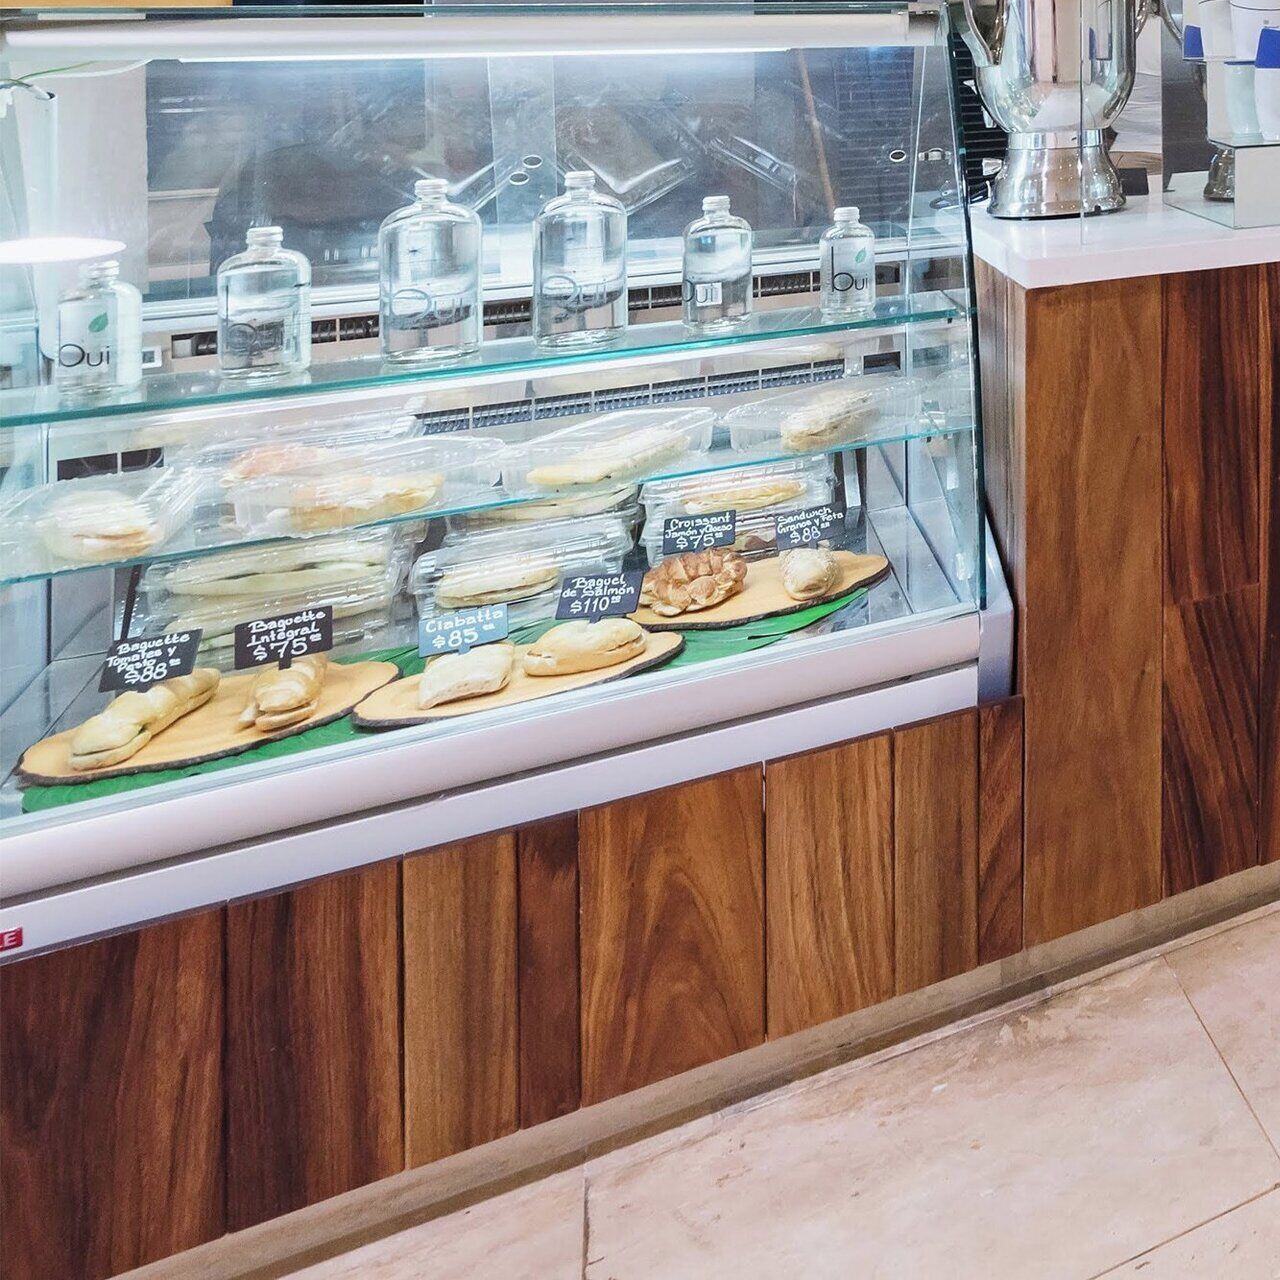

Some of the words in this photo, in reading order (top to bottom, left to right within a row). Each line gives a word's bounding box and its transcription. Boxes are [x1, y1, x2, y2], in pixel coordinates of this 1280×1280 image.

[670, 512, 731, 532] Croissant
[777, 506, 832, 524] Sandwich
[571, 573, 626, 589] Baguel
[561, 588, 577, 598] de
[247, 610, 326, 633] Baguette
[425, 609, 504, 633] Ciabatta
[117, 633, 190, 655] Baguette
[167, 646, 177, 657] y
